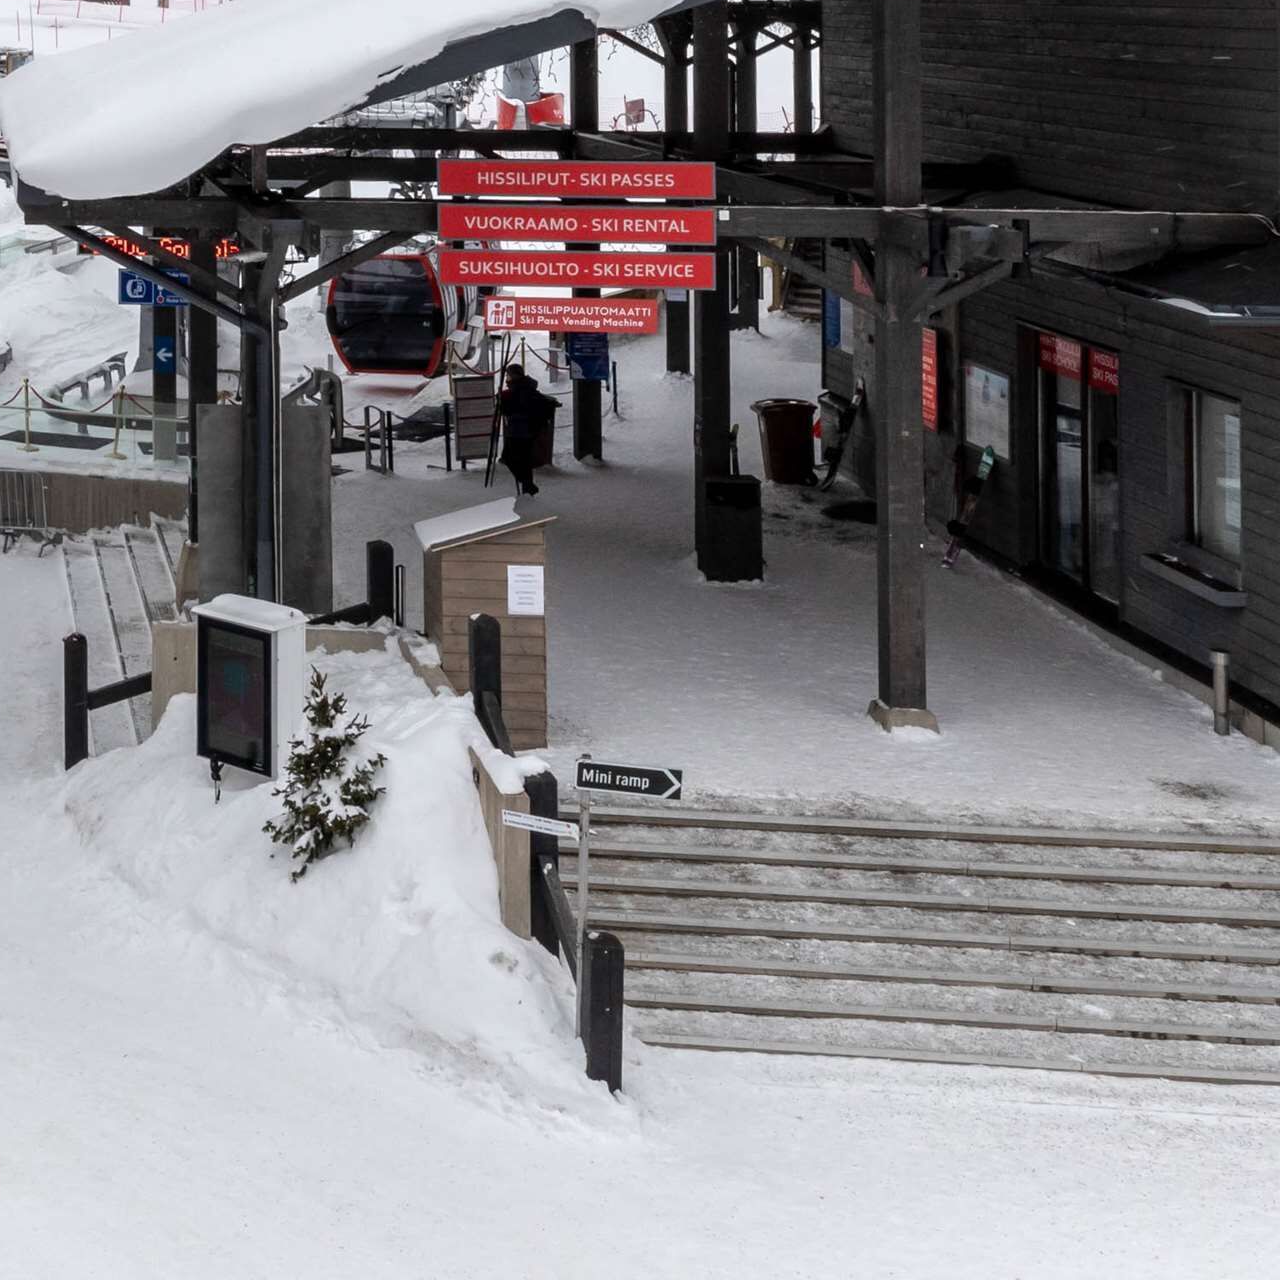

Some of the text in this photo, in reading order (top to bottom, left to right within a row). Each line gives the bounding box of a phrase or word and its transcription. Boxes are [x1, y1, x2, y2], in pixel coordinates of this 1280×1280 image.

[580, 173, 606, 186] SKI
[611, 173, 675, 188] PASSES
[464, 216, 578, 231] VUOKRAAMO
[591, 218, 618, 232] SKI
[624, 219, 690, 233] RENTAL
[459, 261, 579, 277] SUKSIHUOLTO
[593, 263, 619, 277] SKI
[624, 263, 694, 278] SERVICE
[520, 305, 651, 317] HISSILIPPUAUTOMAATTI
[520, 315, 644, 329] Ski Pass Vending Machine
[582, 768, 650, 790] Mini ramp
